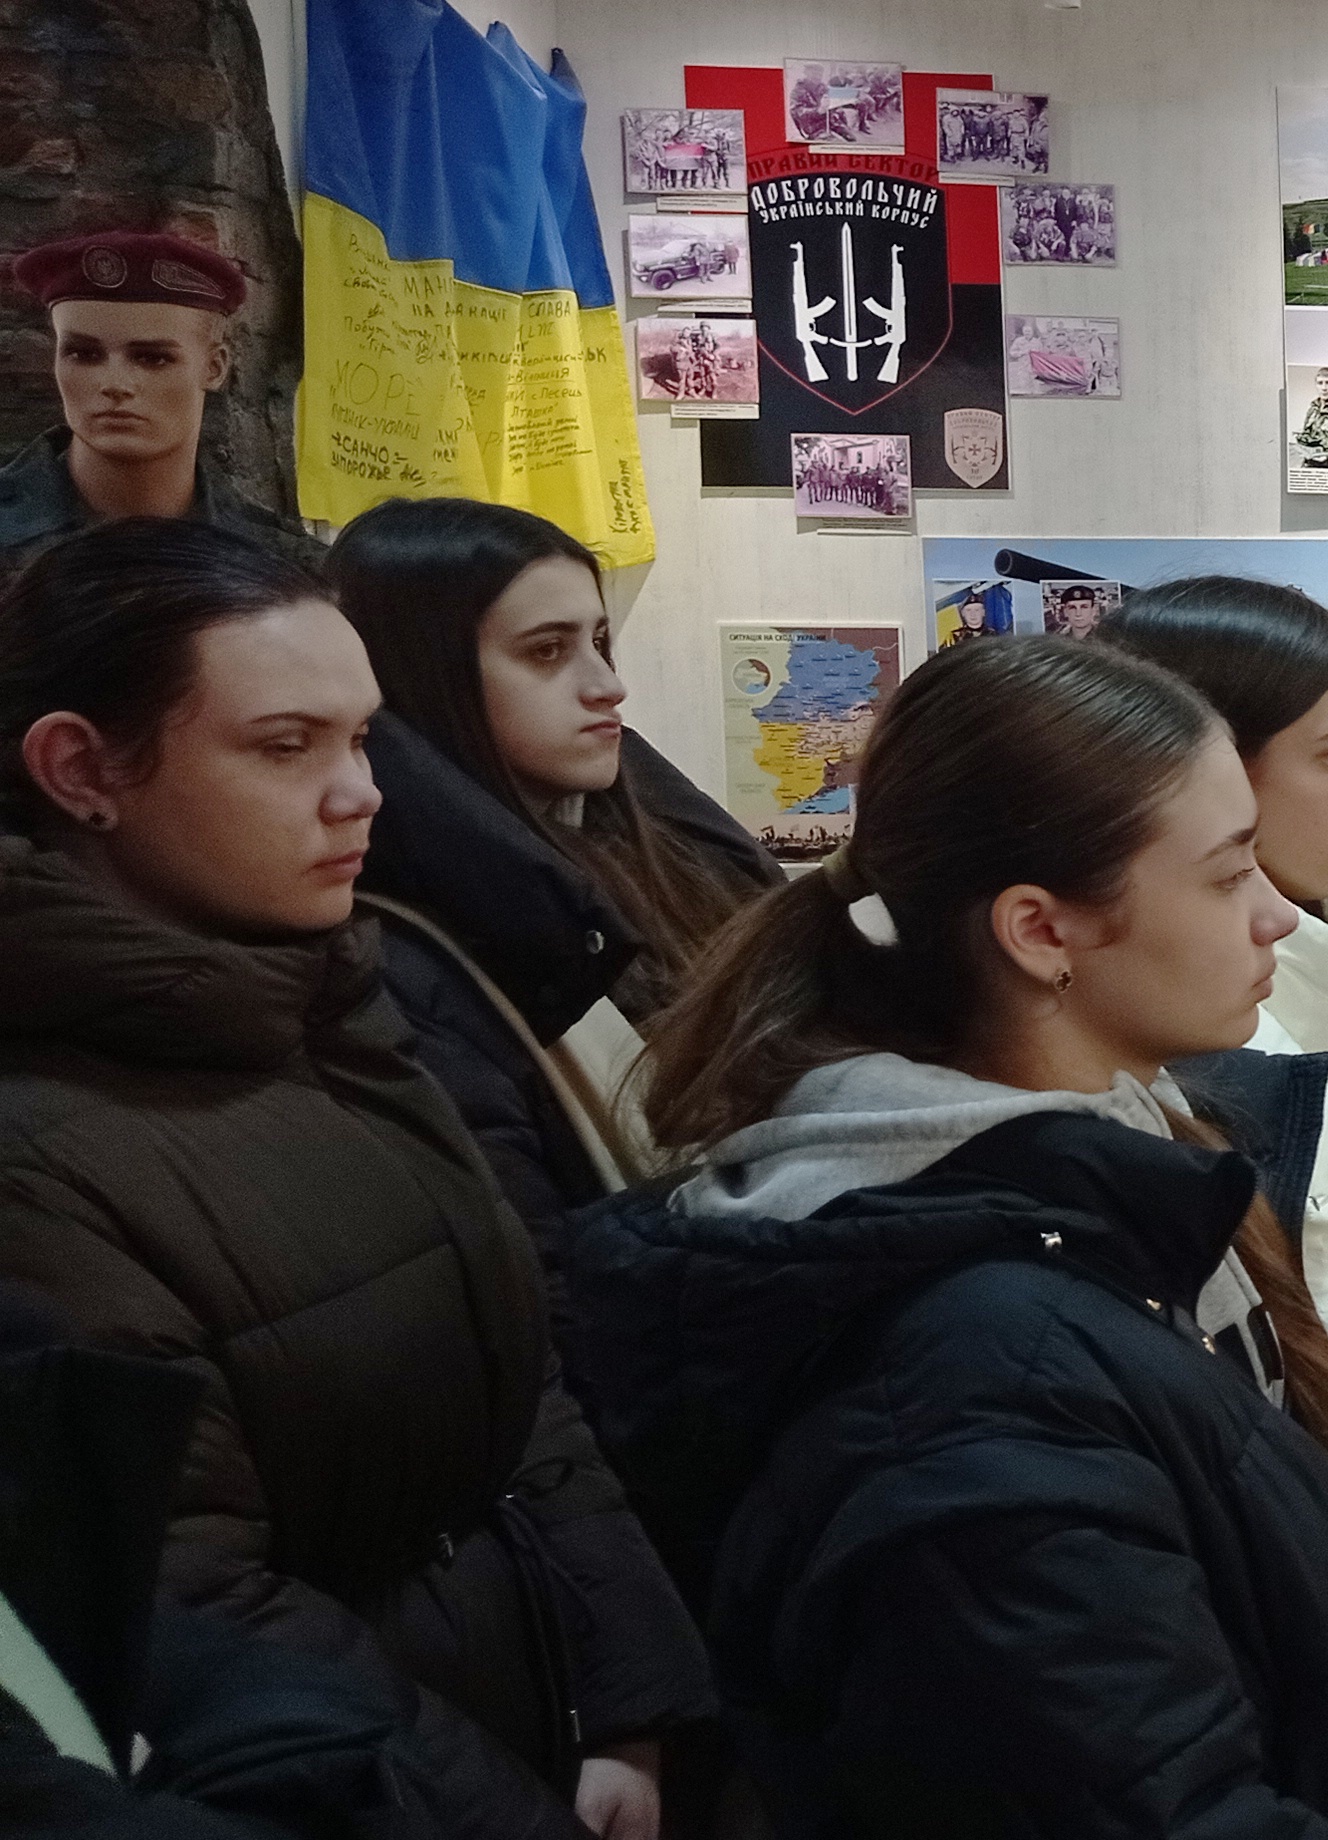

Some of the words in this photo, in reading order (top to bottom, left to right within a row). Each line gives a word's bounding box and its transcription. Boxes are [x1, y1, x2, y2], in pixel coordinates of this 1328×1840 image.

[751, 177, 938, 214] ДОБРОВОЛЬЧИЙ
[759, 199, 864, 223] УКРАЇНСЬКИЙ
[871, 204, 930, 229] КОРПУС
